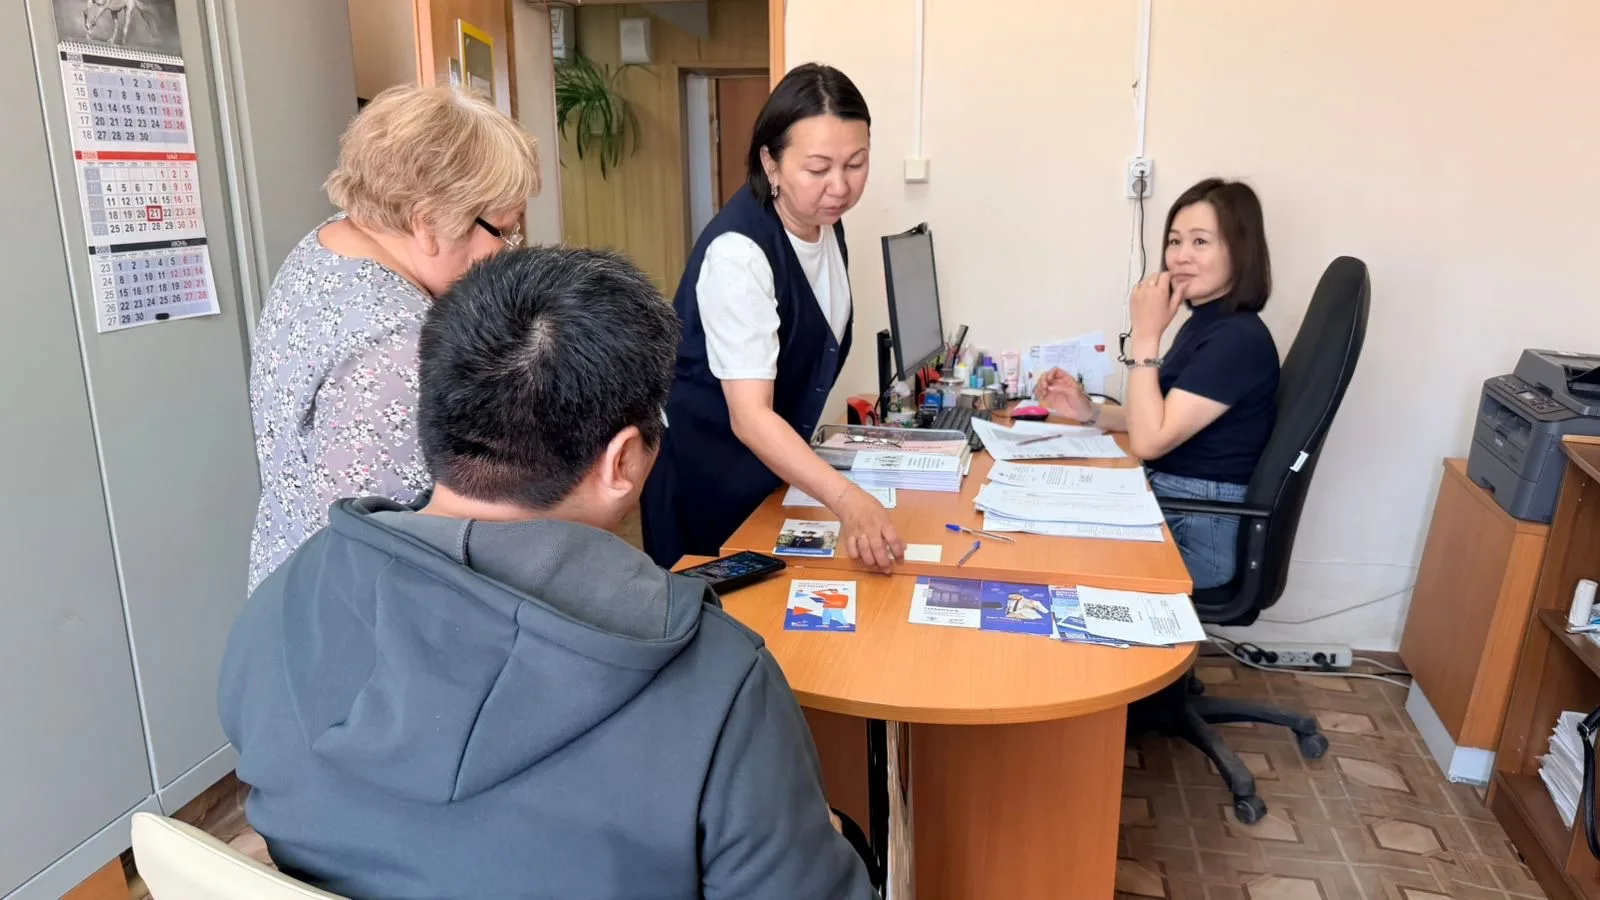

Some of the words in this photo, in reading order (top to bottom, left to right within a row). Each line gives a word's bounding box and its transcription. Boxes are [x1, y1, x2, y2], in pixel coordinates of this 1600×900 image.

[74, 72, 83, 81] 14
[76, 88, 85, 96] 15
[122, 91, 127, 99] 8
[136, 92, 140, 100] 9
[148, 93, 156, 101] 10
[79, 102, 88, 110] 16
[94, 102, 102, 111] 13
[108, 104, 117, 112] 14
[122, 104, 131, 113] 15
[136, 106, 144, 114] 16
[163, 108, 170, 116] 18
[175, 108, 182, 116] 19
[81, 116, 89, 124] 17
[96, 117, 105, 125] 20
[110, 118, 118, 126] 21
[124, 118, 132, 126] 22
[138, 119, 146, 128] 23
[83, 130, 92, 139] 18
[98, 131, 106, 140] 27
[112, 132, 121, 140] 28
[140, 132, 148, 141] 30
[107, 184, 112, 192] 4
[109, 211, 118, 219] 18
[124, 210, 132, 218] 19
[111, 225, 120, 233] 25
[125, 224, 134, 232] 26
[138, 223, 146, 231] 27
[101, 264, 110, 272] 23
[103, 278, 112, 286] 24
[120, 276, 124, 284] 8
[133, 274, 138, 282] 9
[145, 273, 153, 281] 10
[105, 291, 114, 300] 25
[120, 289, 128, 298] 15
[134, 287, 142, 296] 16
[146, 285, 154, 294] 17
[107, 304, 116, 312] 26
[120, 302, 129, 310] 22
[134, 300, 143, 308] 23
[147, 298, 155, 306] 24
[160, 296, 168, 304] 25
[108, 317, 117, 326] 27
[122, 315, 130, 324] 29
[136, 313, 144, 321] 30
